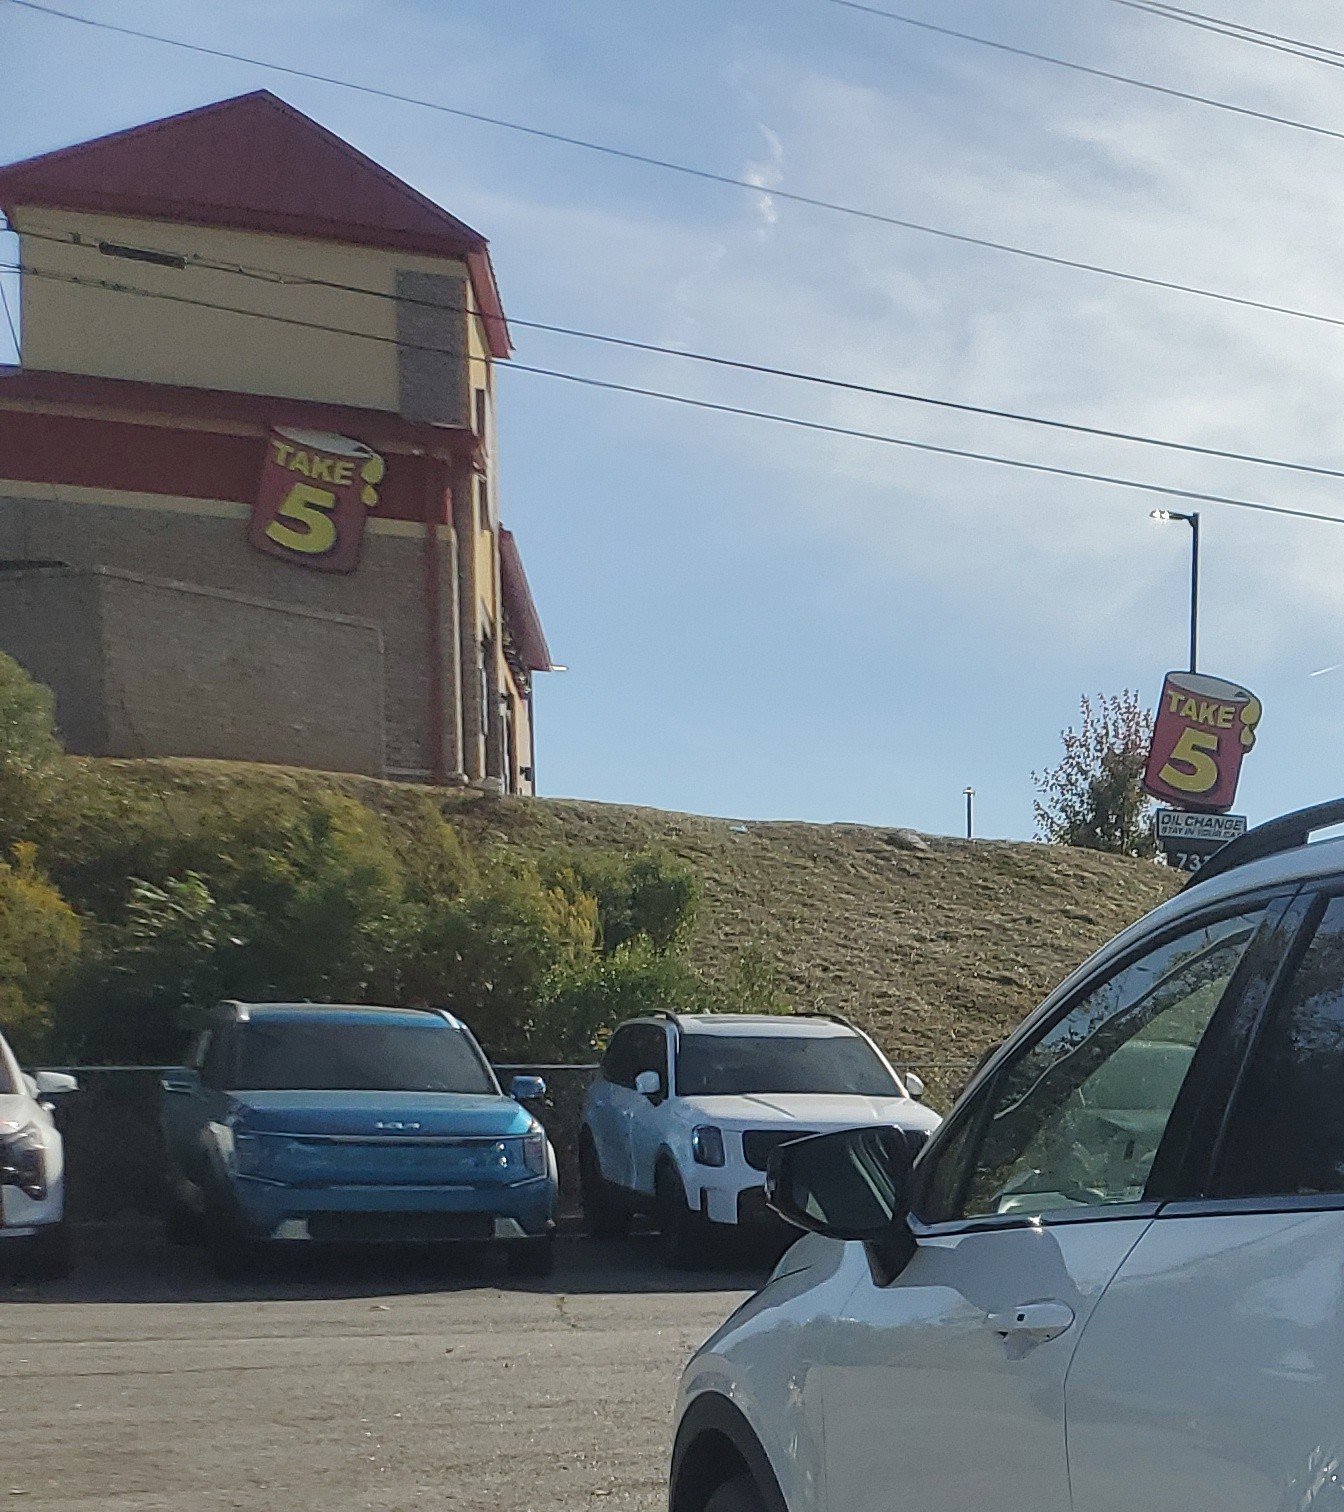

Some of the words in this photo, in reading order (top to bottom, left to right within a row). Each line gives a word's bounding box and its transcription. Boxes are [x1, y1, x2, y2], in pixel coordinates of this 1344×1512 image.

[271, 440, 355, 485] TAKE
[265, 483, 337, 554] 5
[1167, 691, 1236, 729] TAKE
[1158, 727, 1220, 793] 5
[1161, 814, 1182, 825] OIL
[1184, 815, 1243, 831] CHANGE
